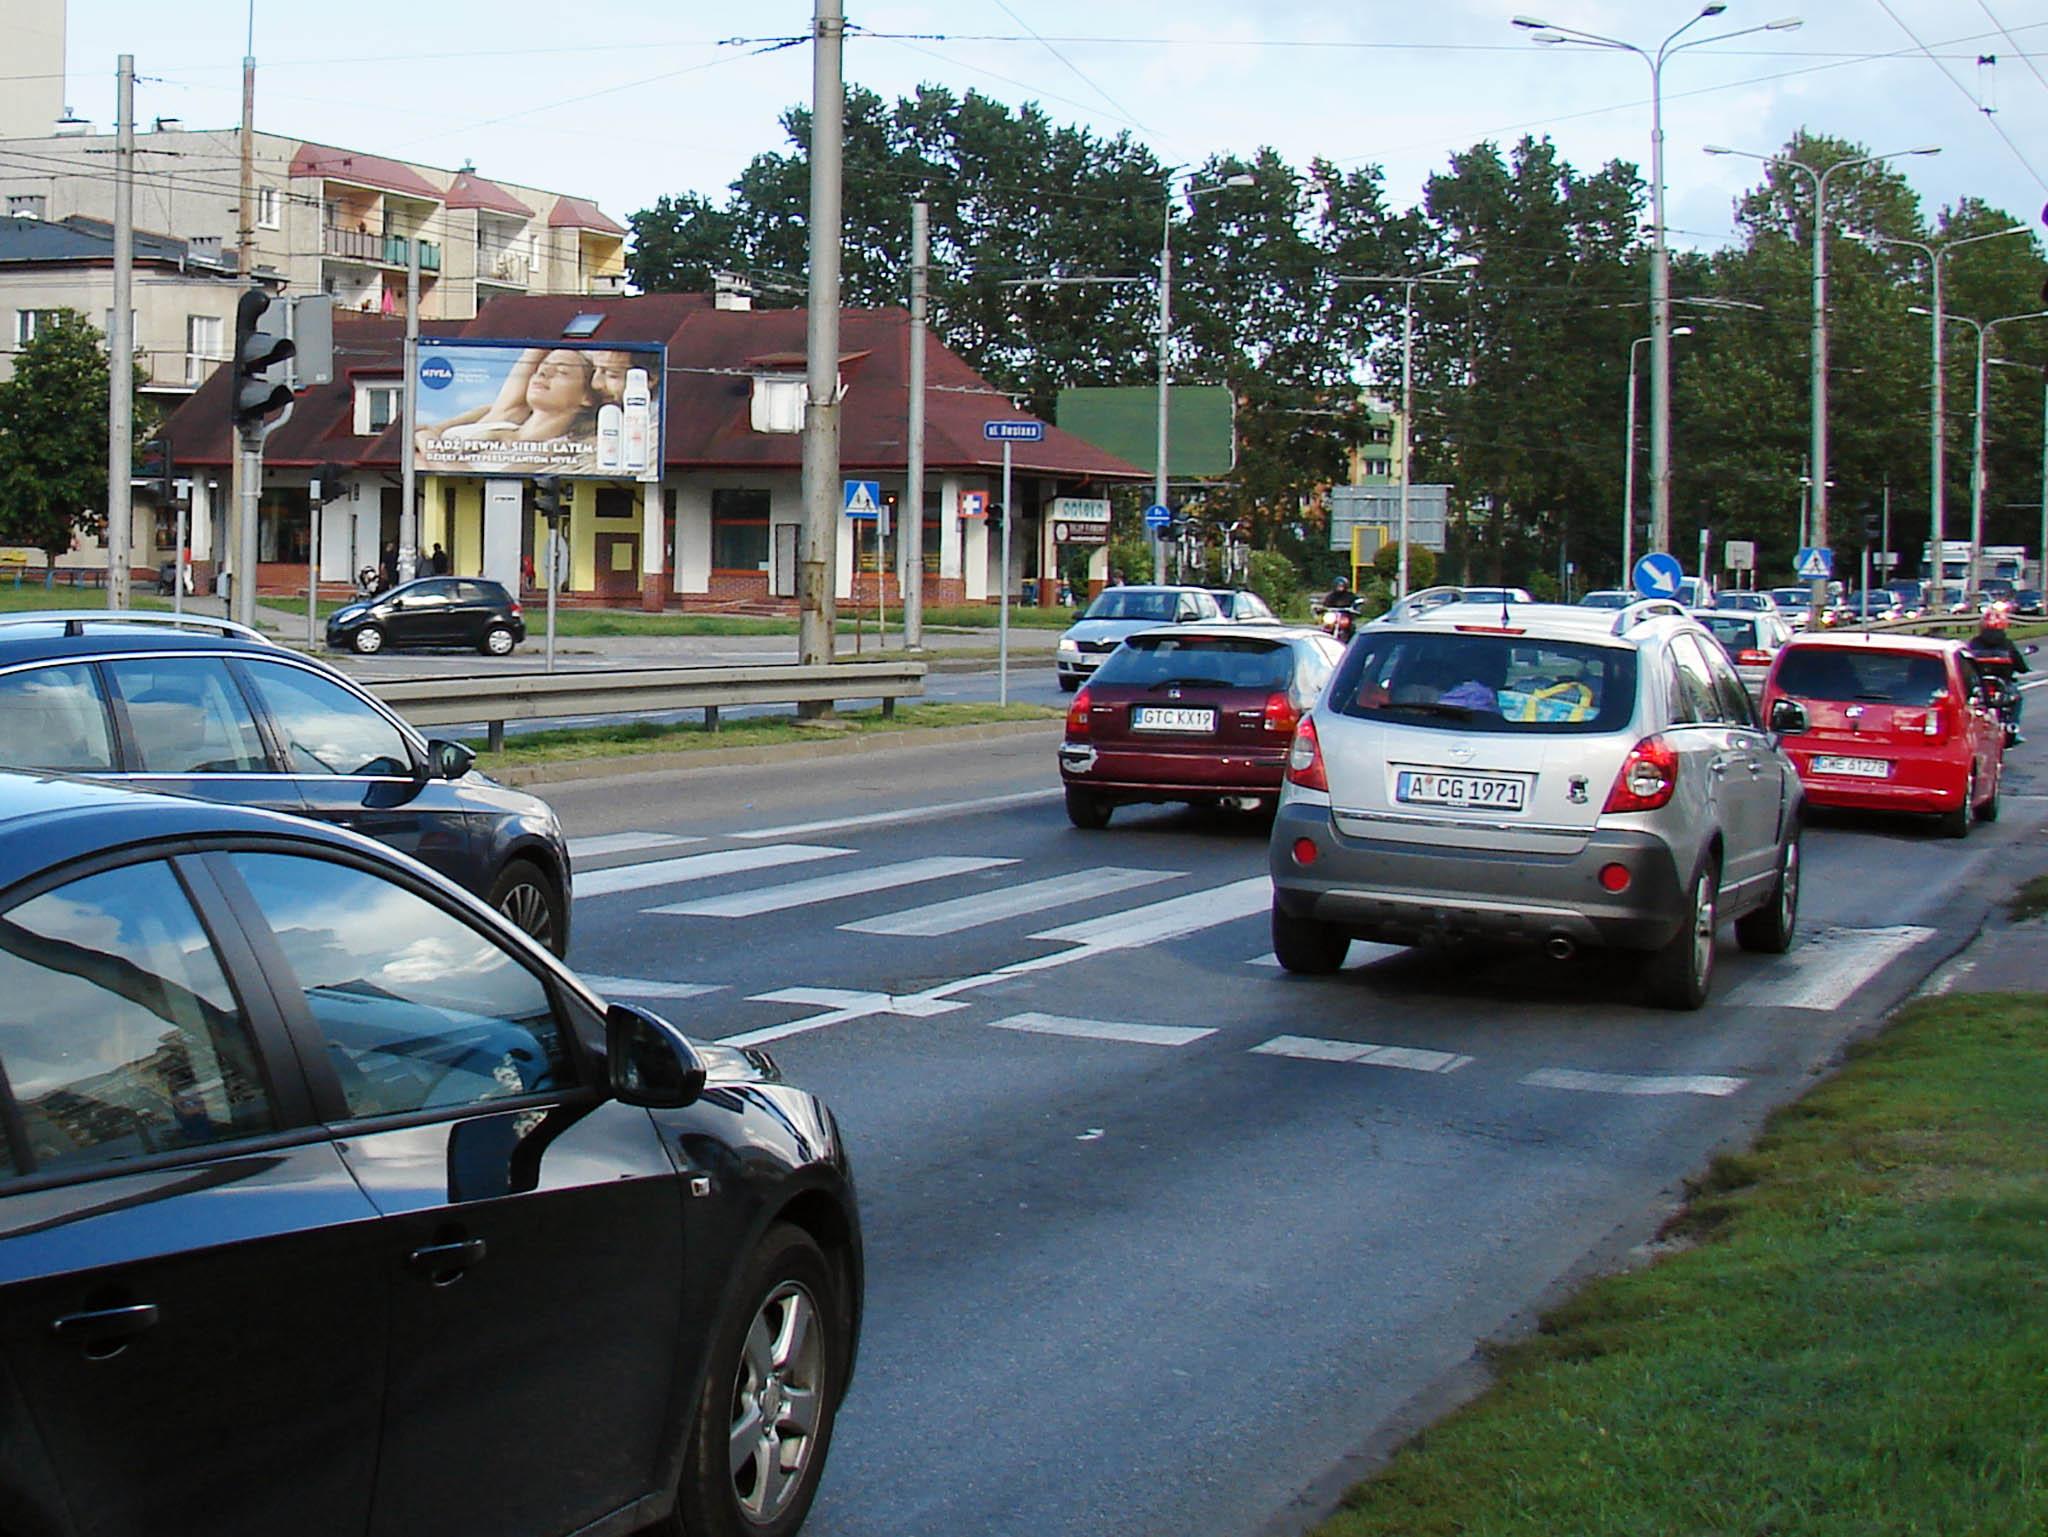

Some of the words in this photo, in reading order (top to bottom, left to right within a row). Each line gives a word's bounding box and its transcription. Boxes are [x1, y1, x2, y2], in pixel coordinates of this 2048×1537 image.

[422, 369, 452, 378] NIVEA
[464, 441, 506, 451] PEWNA
[511, 441, 549, 453] SIEBIE
[553, 443, 593, 454] LATEM
[550, 455, 577, 464] NIVEA
[1144, 710, 1174, 724] GTC
[1411, 776, 1423, 796] A
[1437, 778, 1463, 799] CG
[1468, 781, 1519, 804] 1971
